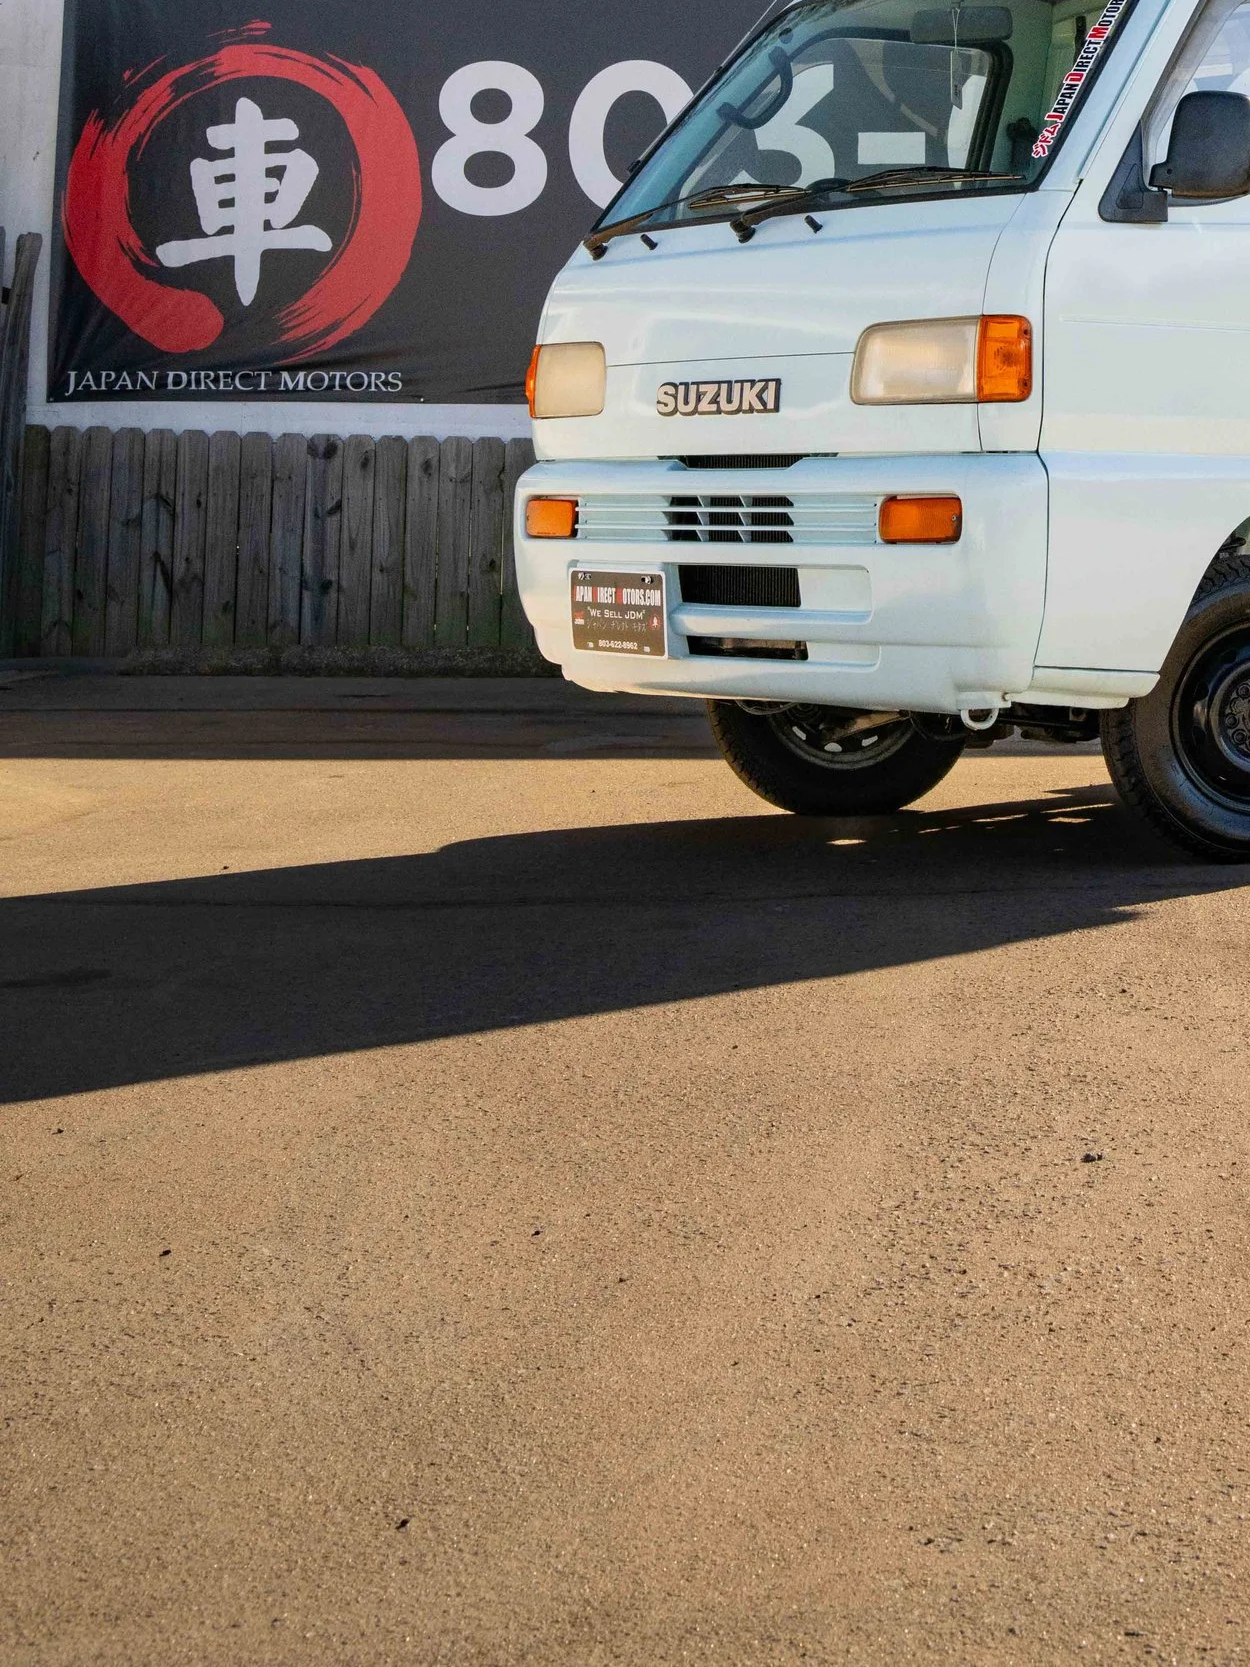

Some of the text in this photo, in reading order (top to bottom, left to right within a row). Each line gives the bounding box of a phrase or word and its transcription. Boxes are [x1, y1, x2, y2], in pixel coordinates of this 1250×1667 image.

[155, 96, 333, 307] 車
[65, 371, 403, 396] JAPAN DIRECT MOTORS
[656, 378, 782, 417] SUZUKI
